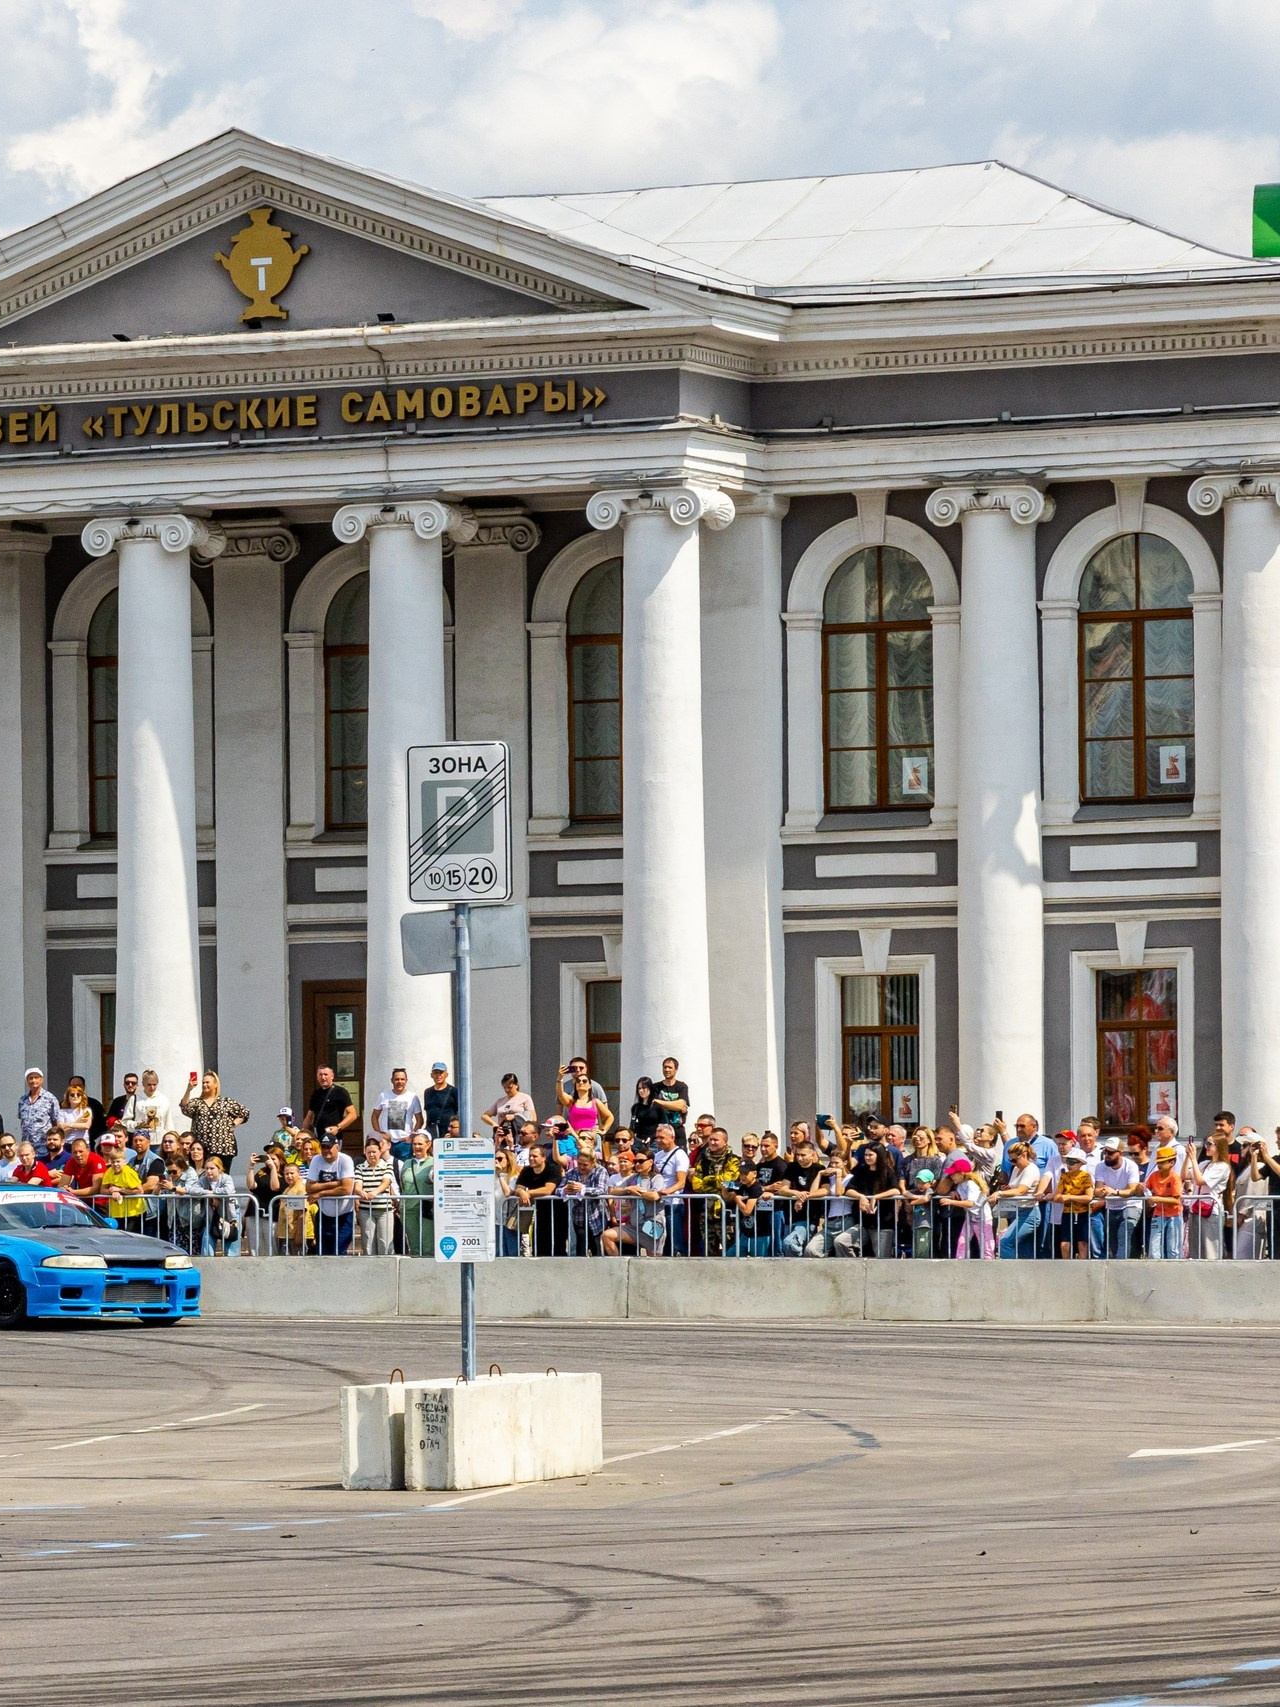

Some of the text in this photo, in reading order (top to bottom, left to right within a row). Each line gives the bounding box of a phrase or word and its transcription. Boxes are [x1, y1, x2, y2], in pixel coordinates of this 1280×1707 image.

[82, 395, 317, 437] «ТУЛЬСКИЕ
[341, 380, 606, 423] САМОВАРЫ»
[428, 756, 488, 774] ЗОНА
[428, 866, 493, 886] 10 15 20
[461, 1238, 481, 1246] 2001
